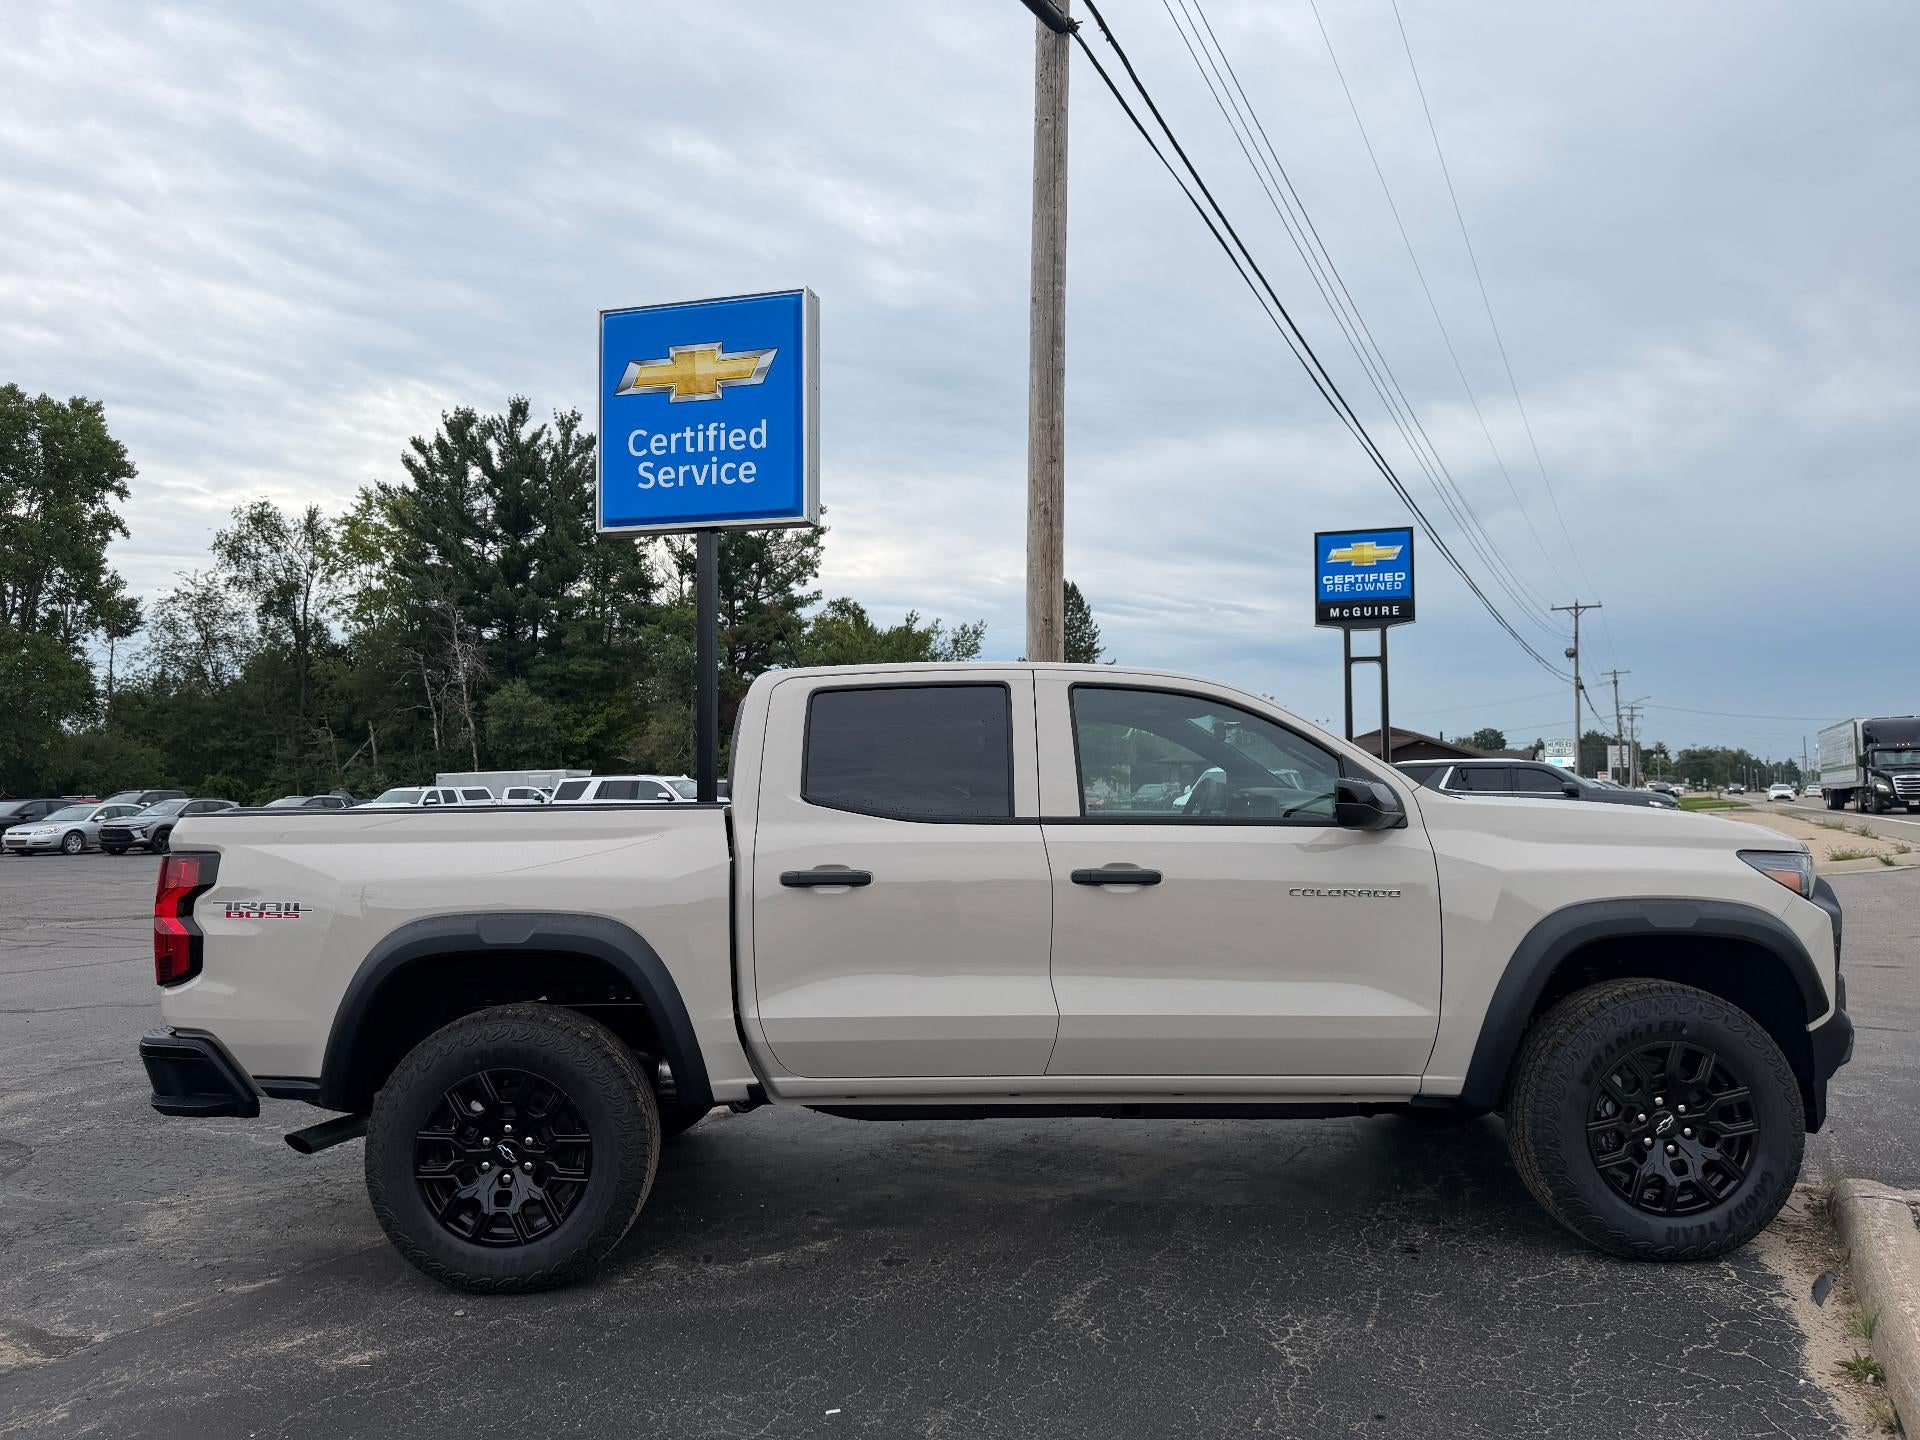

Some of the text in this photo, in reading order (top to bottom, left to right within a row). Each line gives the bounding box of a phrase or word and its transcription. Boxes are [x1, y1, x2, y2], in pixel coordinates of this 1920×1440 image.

[628, 419, 767, 457] Certified
[637, 456, 757, 489] Service
[1322, 572, 1406, 585] CERTIFIED
[1326, 581, 1402, 593] PRE-OWNED
[1329, 605, 1400, 617] McGUIRE
[1289, 888, 1401, 898] COLORADO
[213, 901, 313, 912] TRAIL
[225, 911, 300, 919] BOSS
